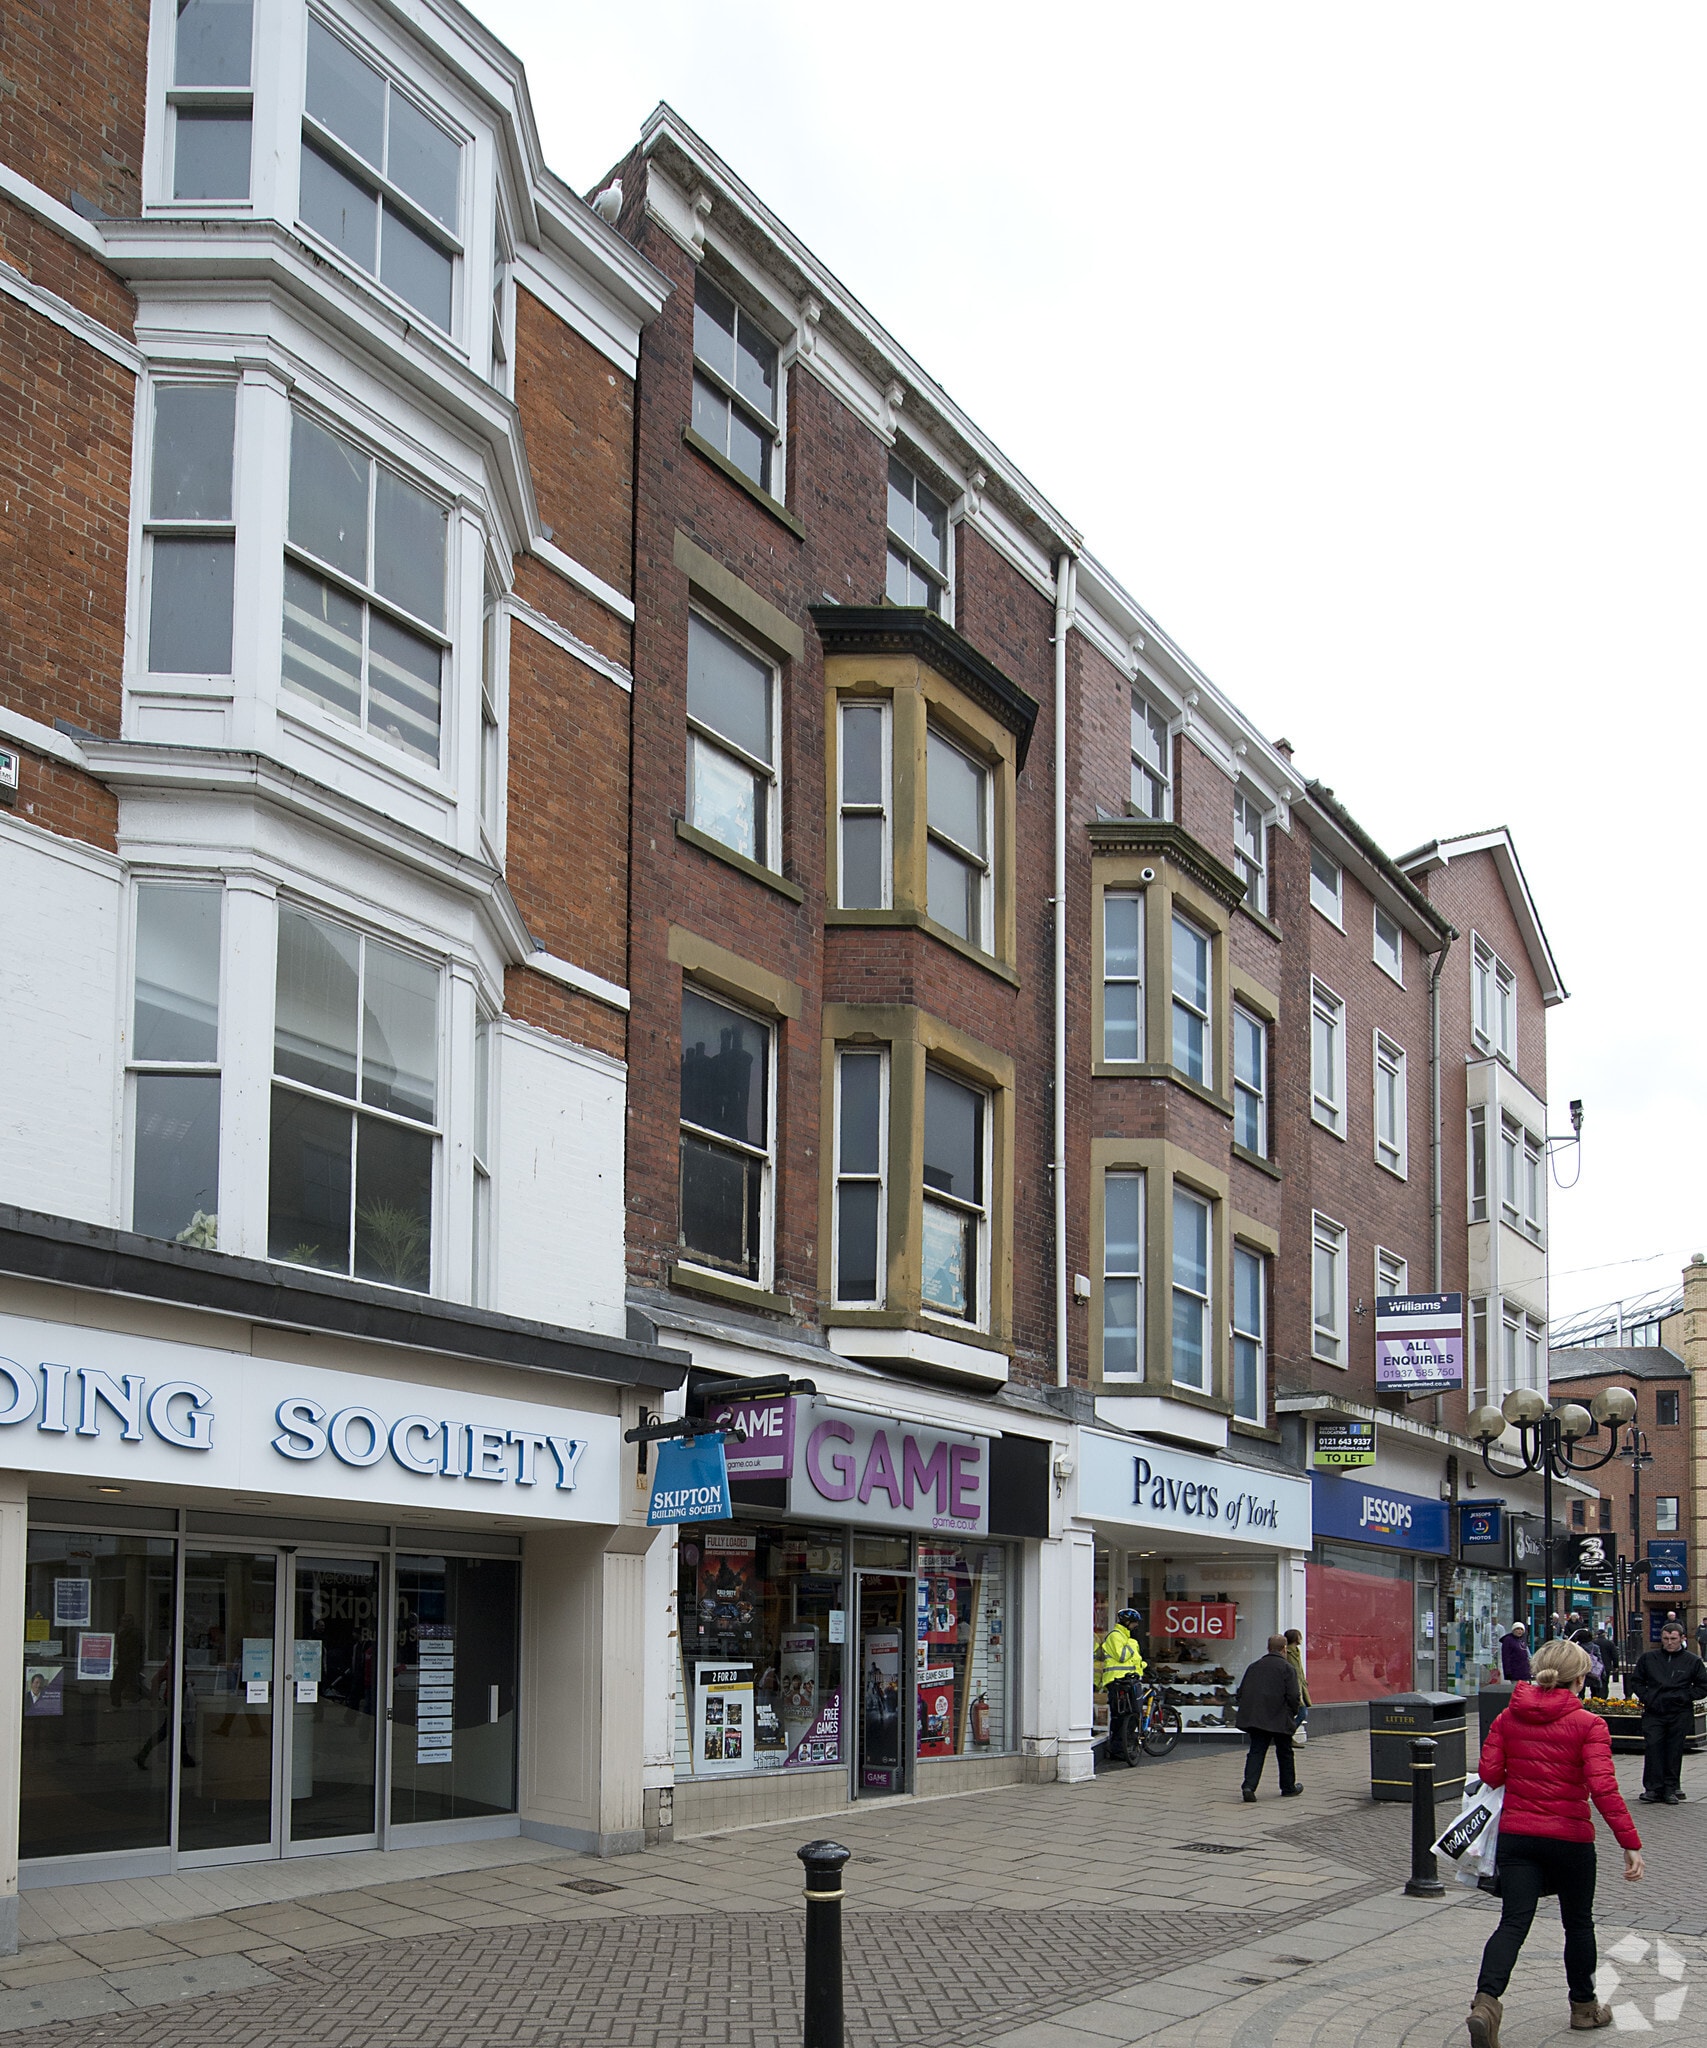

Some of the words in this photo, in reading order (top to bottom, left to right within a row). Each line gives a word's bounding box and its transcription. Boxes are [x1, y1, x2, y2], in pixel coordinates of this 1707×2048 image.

[1388, 1300, 1441, 1312] Williams
[1406, 1342, 1431, 1351] ALL
[1384, 1354, 1454, 1366] ENQUIRIES
[1384, 1370, 1412, 1378] 01937
[1416, 1368, 1434, 1377] 585
[1437, 1368, 1454, 1376] 750
[271, 1397, 588, 1490] SOCIETY
[727, 1459, 761, 1470] game.co.uk
[1325, 1454, 1341, 1462] TO
[1345, 1454, 1364, 1462] LET
[806, 1420, 980, 1519] GAME
[654, 1486, 721, 1510] SKIPTON
[1131, 1456, 1219, 1519] Pavers
[1226, 1492, 1246, 1530] of
[1247, 1494, 1279, 1529] York
[652, 1508, 686, 1519] BUILDING
[688, 1504, 722, 1515] SOCIETY
[1360, 1496, 1412, 1528] JESSOPS
[932, 1516, 977, 1530] game.co.uk
[708, 1536, 724, 1547] FULLY
[726, 1538, 747, 1548] LOADED
[1516, 1526, 1525, 1560] 3
[1579, 1537, 1605, 1566] 3
[312, 1588, 408, 1627] Skiptn
[1164, 1606, 1223, 1635] Sale
[712, 1673, 716, 1682] 2
[718, 1672, 729, 1682] FOR
[730, 1671, 737, 1681] 20
[834, 1695, 839, 1707] 3
[824, 1708, 839, 1721] FREE
[1385, 1716, 1415, 1724] LITTER
[817, 1721, 838, 1734] GAMES
[867, 1773, 887, 1782] GAME
[1443, 1810, 1486, 1853] bodycare
